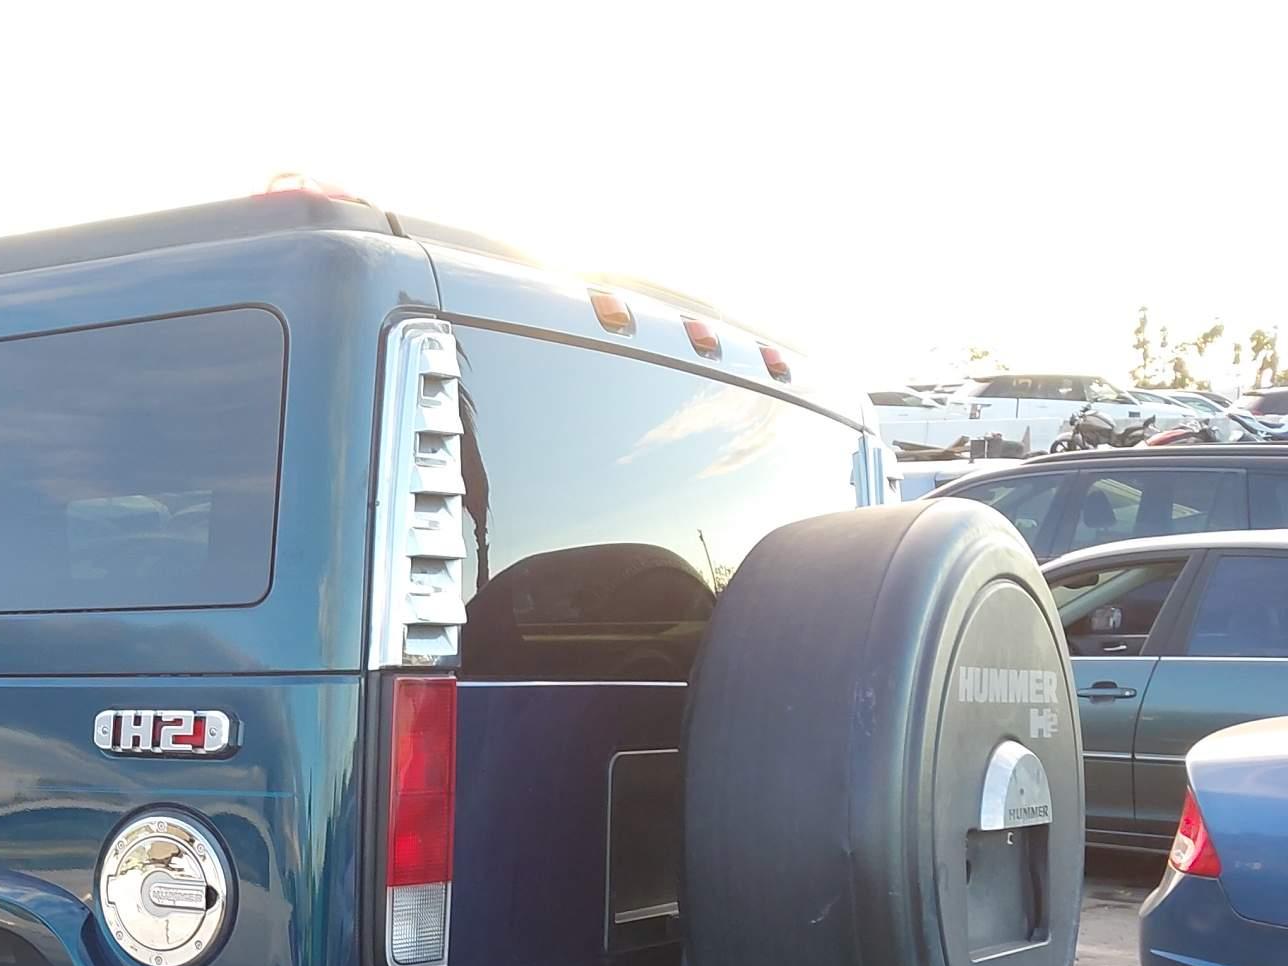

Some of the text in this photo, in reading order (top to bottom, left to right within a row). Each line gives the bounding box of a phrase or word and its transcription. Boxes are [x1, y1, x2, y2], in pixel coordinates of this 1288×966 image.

[958, 666, 1059, 704] HUMMER
[120, 710, 194, 751] H2
[1008, 805, 1049, 821] HUMMER
